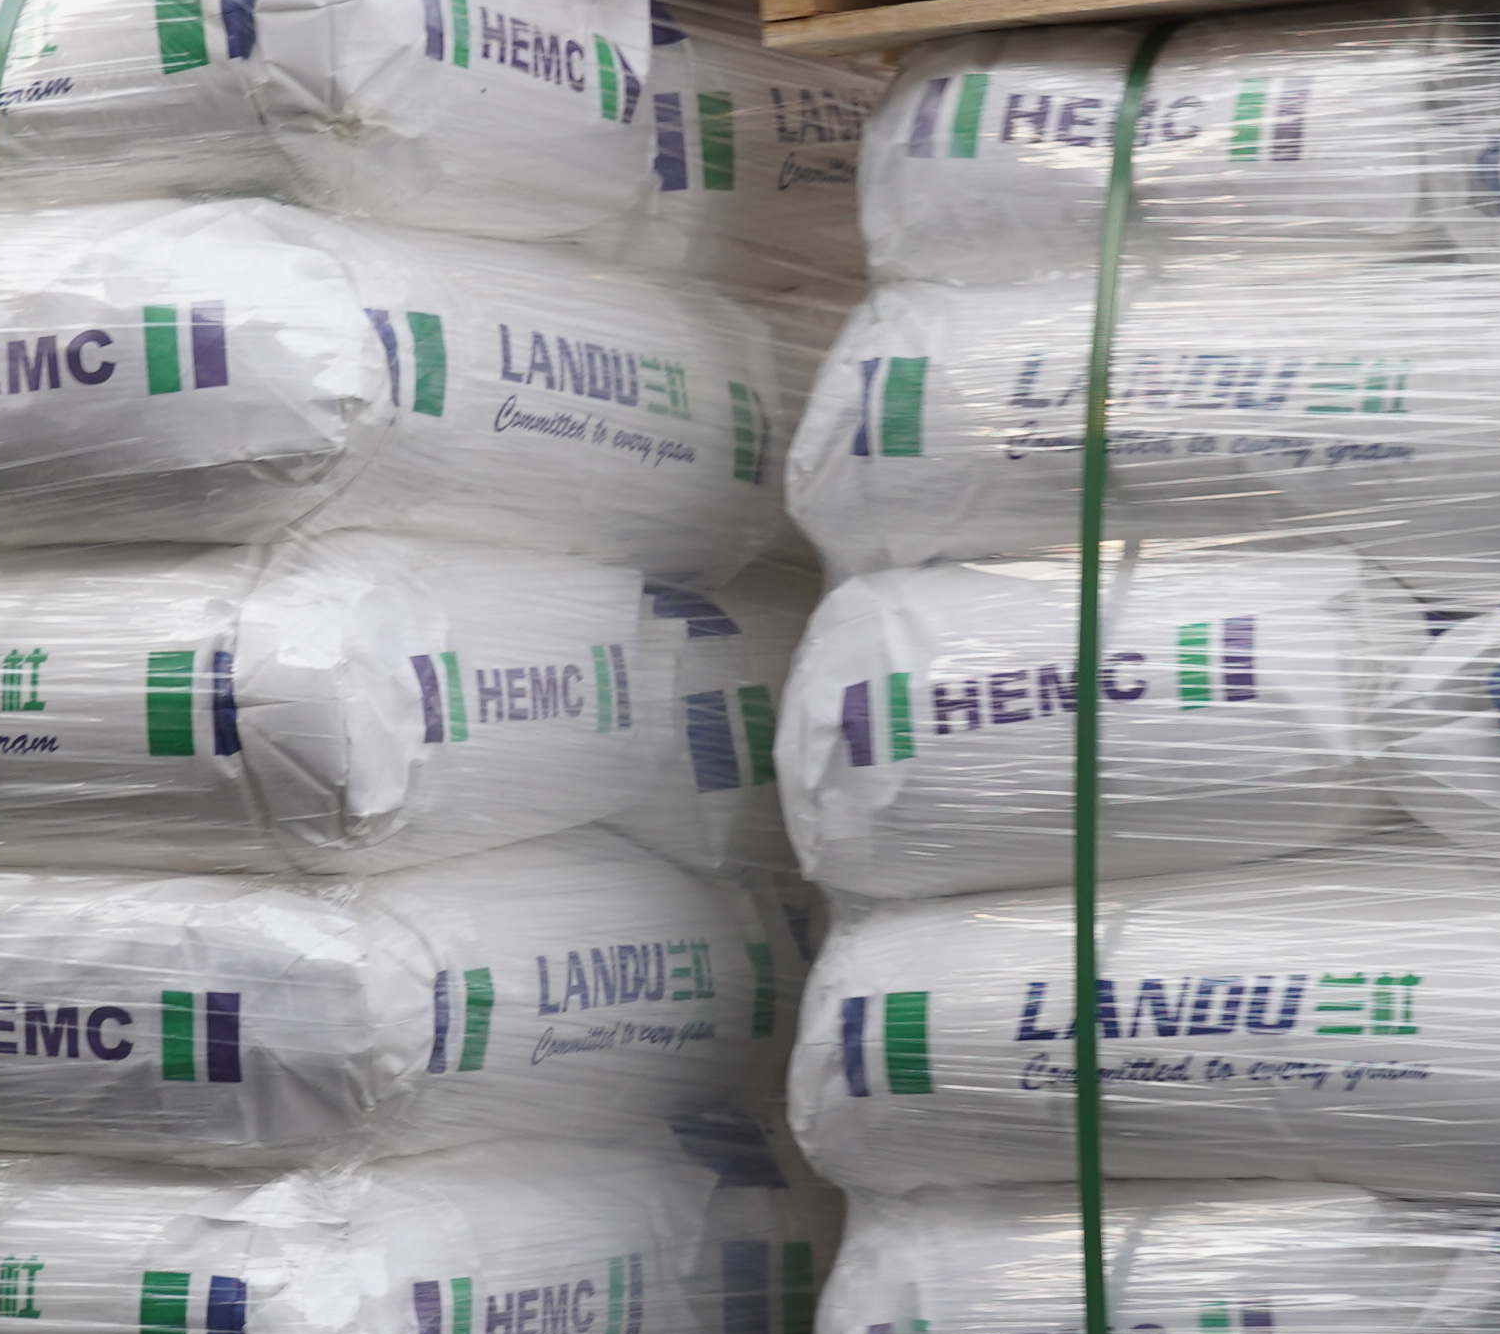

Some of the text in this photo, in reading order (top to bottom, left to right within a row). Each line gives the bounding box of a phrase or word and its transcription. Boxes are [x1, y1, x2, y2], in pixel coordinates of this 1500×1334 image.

[480, 5, 586, 92] HEMC
[498, 322, 640, 408] LANDU
[494, 394, 586, 444] Committed
[475, 663, 585, 724] HEMC
[536, 941, 666, 1016] LANDU
[531, 1020, 619, 1066] Committed
[1204, 1055, 1235, 1080] to
